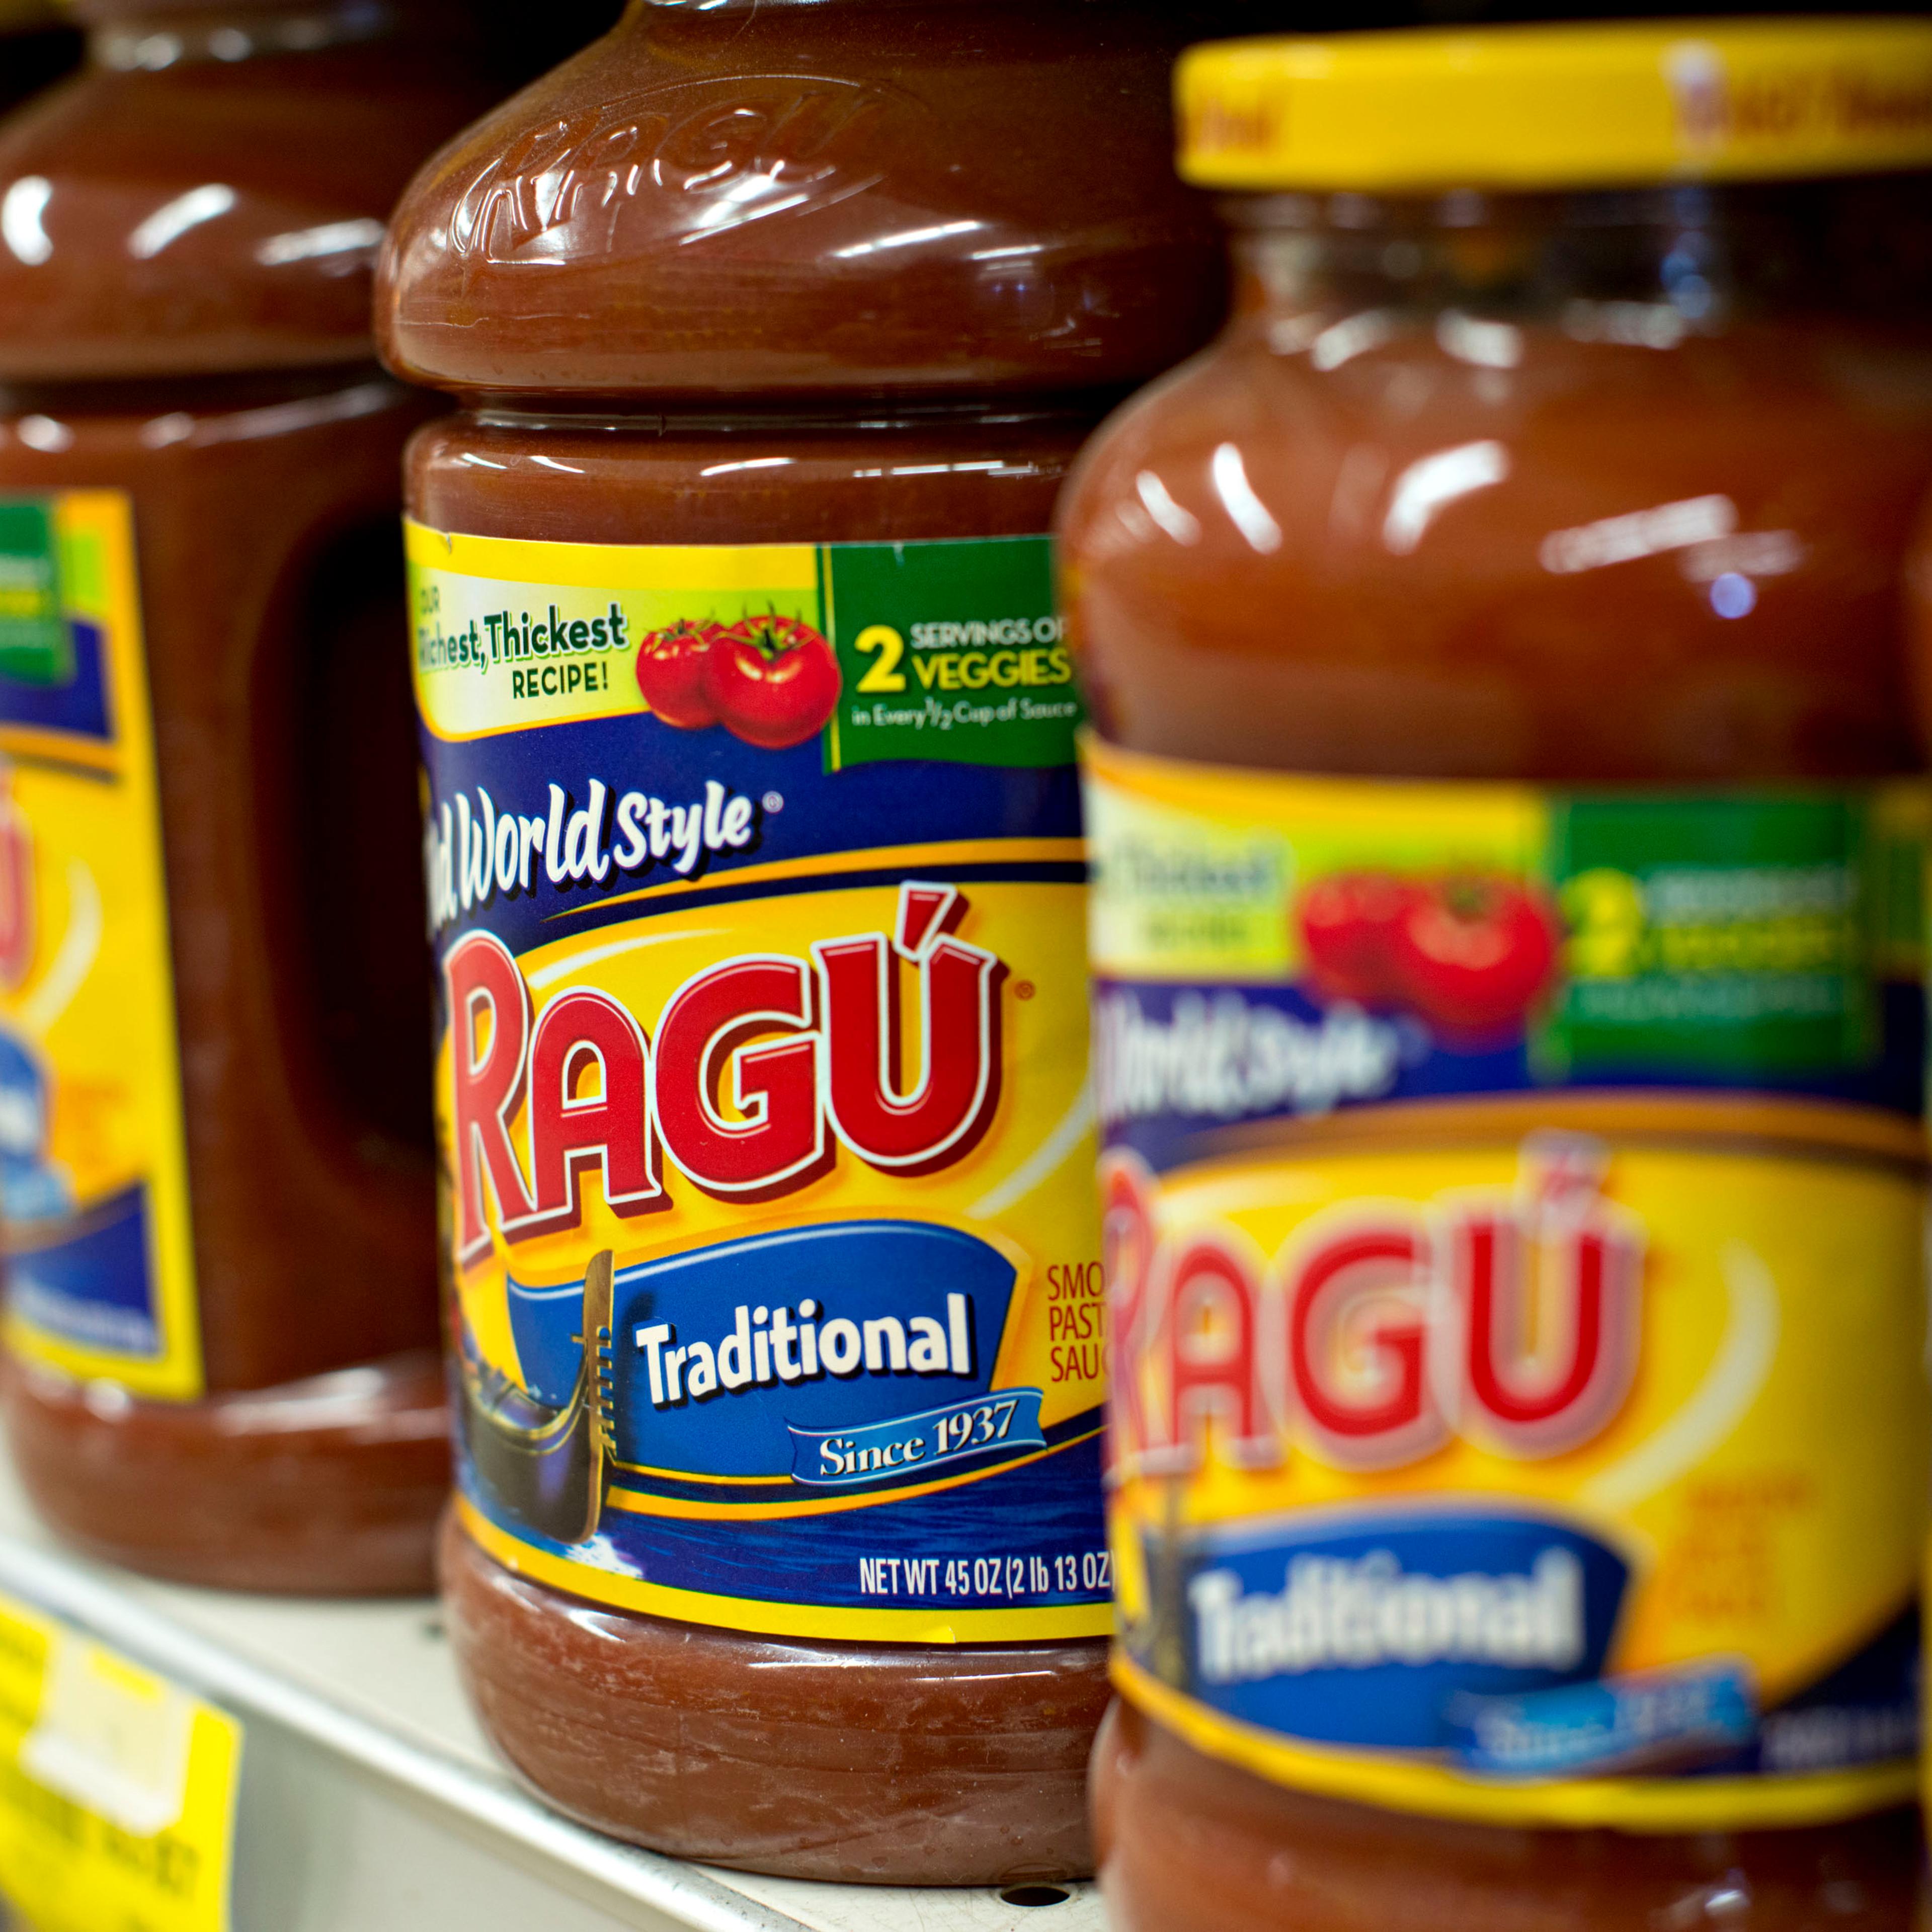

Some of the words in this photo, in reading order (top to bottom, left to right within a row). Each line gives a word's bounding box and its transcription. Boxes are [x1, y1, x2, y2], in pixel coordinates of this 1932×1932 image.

[483, 604, 625, 659] Thickest
[910, 618, 1032, 649] SERVINGS
[512, 661, 609, 699] RECIPE!
[854, 624, 906, 694] 2
[911, 647, 1071, 690] VEGGIES
[852, 705, 871, 726] in
[872, 703, 925, 730] Every
[953, 700, 995, 727] Cup
[996, 697, 1017, 720] of
[1019, 697, 1078, 720] Sauce
[455, 777, 610, 912] World
[613, 780, 753, 874] Style
[443, 880, 1001, 1263] RAGÚ
[1047, 1261, 1106, 1301] SMO
[1049, 1301, 1107, 1342] PAST
[635, 1292, 972, 1406] Traditional
[1050, 1342, 1111, 1383] SAU
[820, 1437, 927, 1476] Since
[933, 1400, 1019, 1456] 1937
[859, 1558, 900, 1594] NET
[904, 1559, 940, 1595] WT
[945, 1560, 971, 1595] 45
[974, 1558, 1003, 1595] OZ
[1006, 1556, 1025, 1599] (2
[1030, 1556, 1050, 1593] lb
[1055, 1555, 1078, 1591] 13
